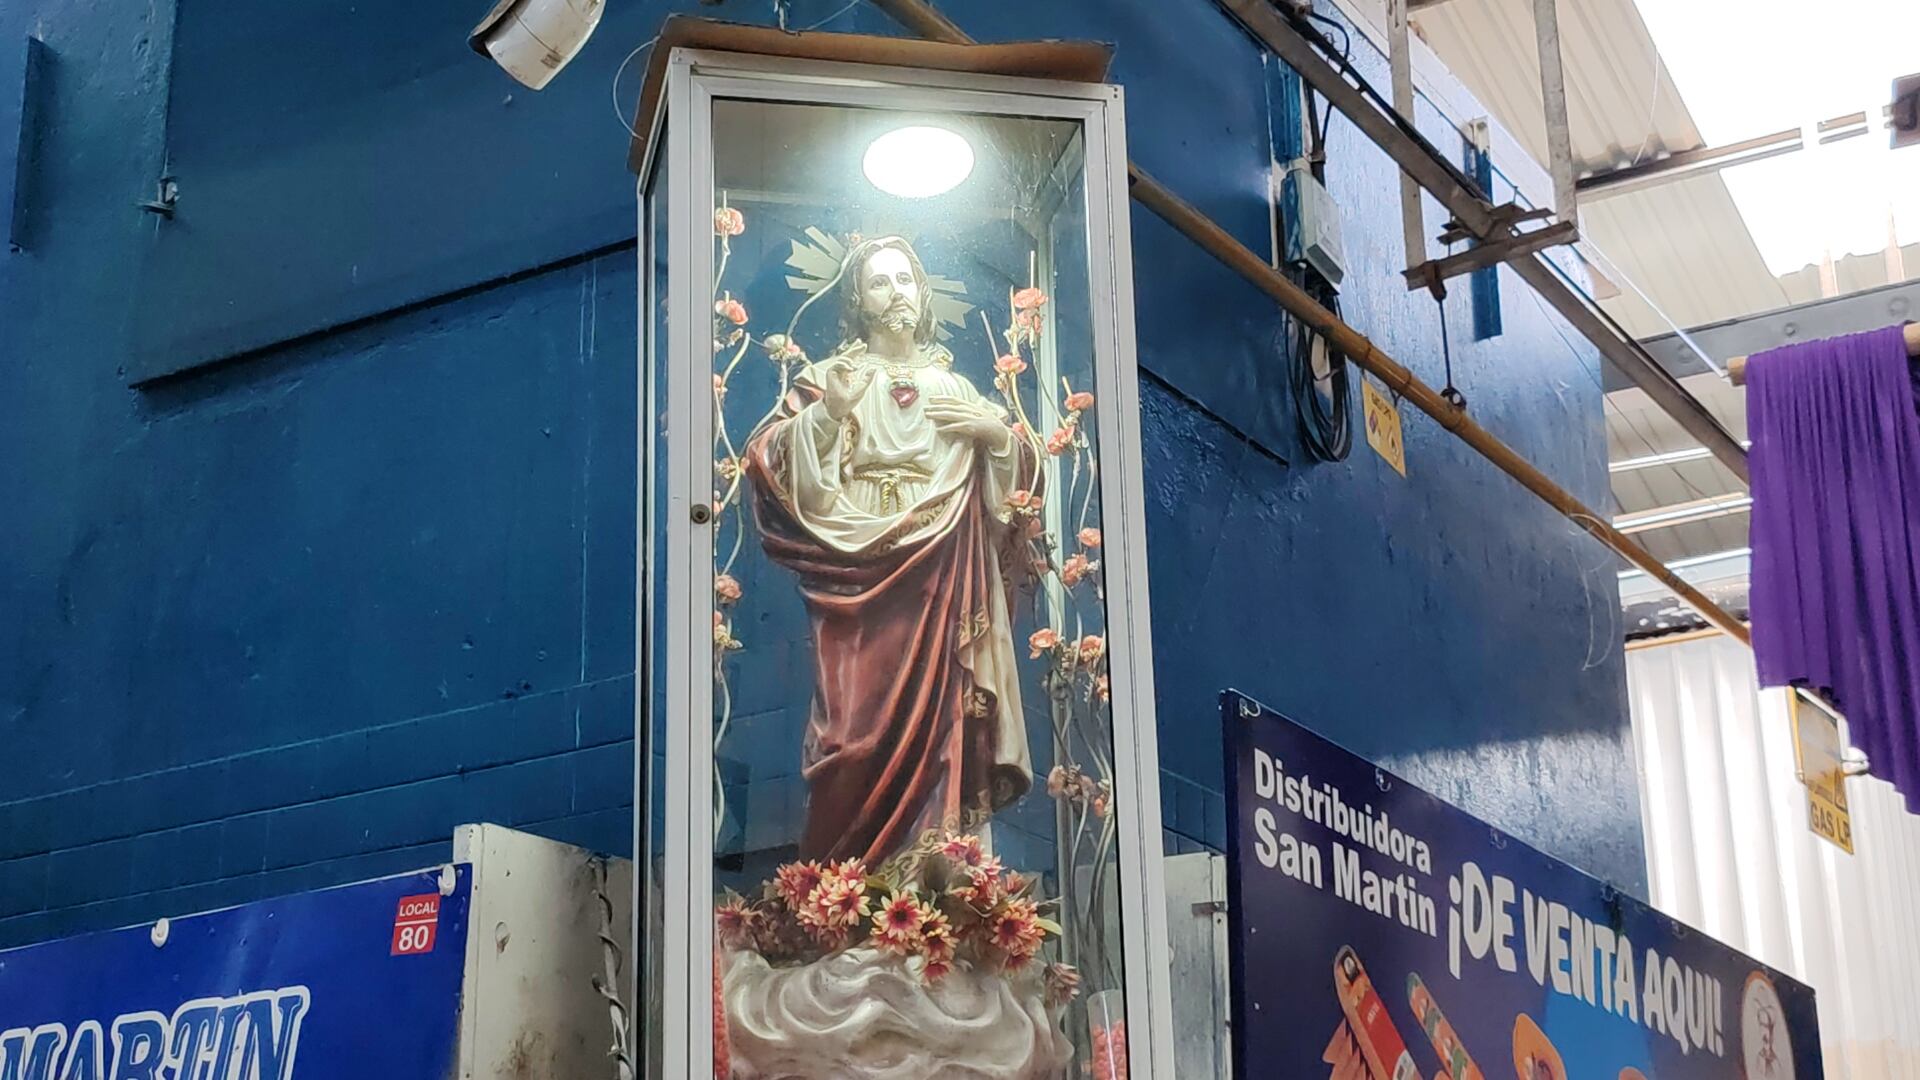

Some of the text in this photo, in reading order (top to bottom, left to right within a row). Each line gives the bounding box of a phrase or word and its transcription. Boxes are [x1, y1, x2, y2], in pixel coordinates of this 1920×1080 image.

[1254, 748, 1432, 875] Distribuidora
[1811, 801, 1835, 838] GAS
[399, 901, 438, 917] LOCAL
[1254, 807, 1437, 938] San Martin
[398, 925, 429, 951] 80
[1448, 861, 1725, 1058] ¡DE VENTA AQUI!
